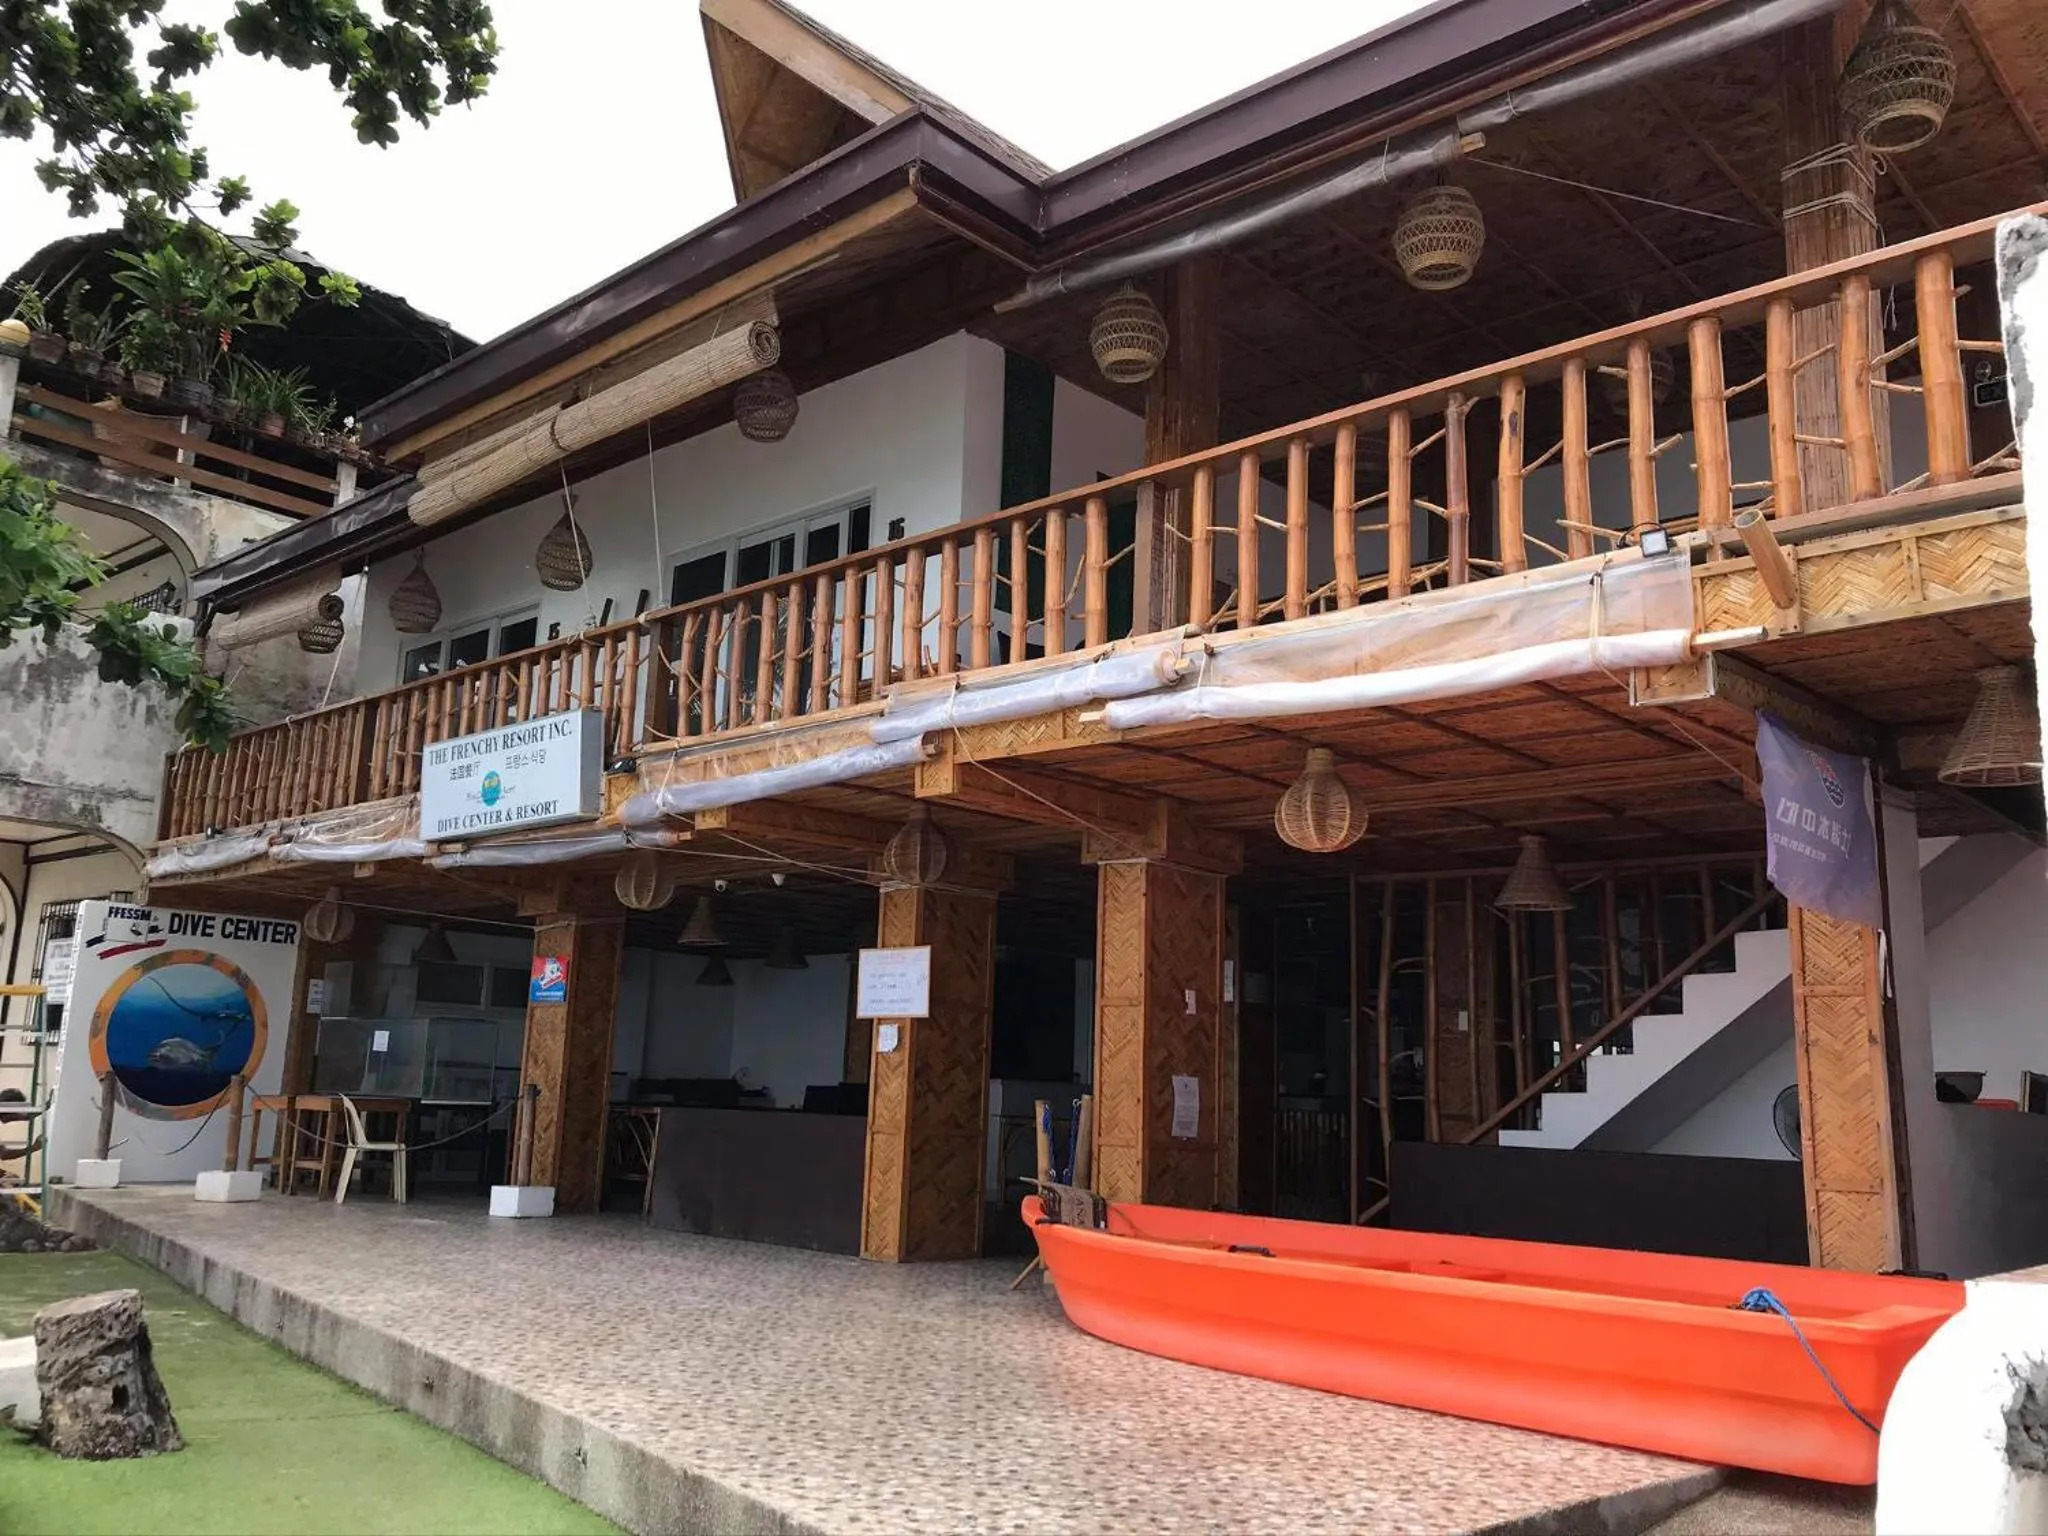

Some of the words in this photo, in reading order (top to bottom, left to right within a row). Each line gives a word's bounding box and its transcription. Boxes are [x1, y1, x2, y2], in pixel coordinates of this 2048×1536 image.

[428, 747, 449, 766] THE
[451, 736, 499, 761] FRENCHY
[502, 725, 546, 750] RESORT
[548, 719, 572, 740] INC.
[505, 753, 529, 770] 프랑스
[531, 749, 547, 764] 식당
[437, 816, 460, 833] DIVE
[462, 809, 502, 829] CENTER
[505, 808, 513, 821] &
[516, 800, 559, 819] RESORT
[108, 906, 152, 921] FFESSM
[168, 912, 216, 938] DIVE
[221, 916, 297, 945] CENTER
